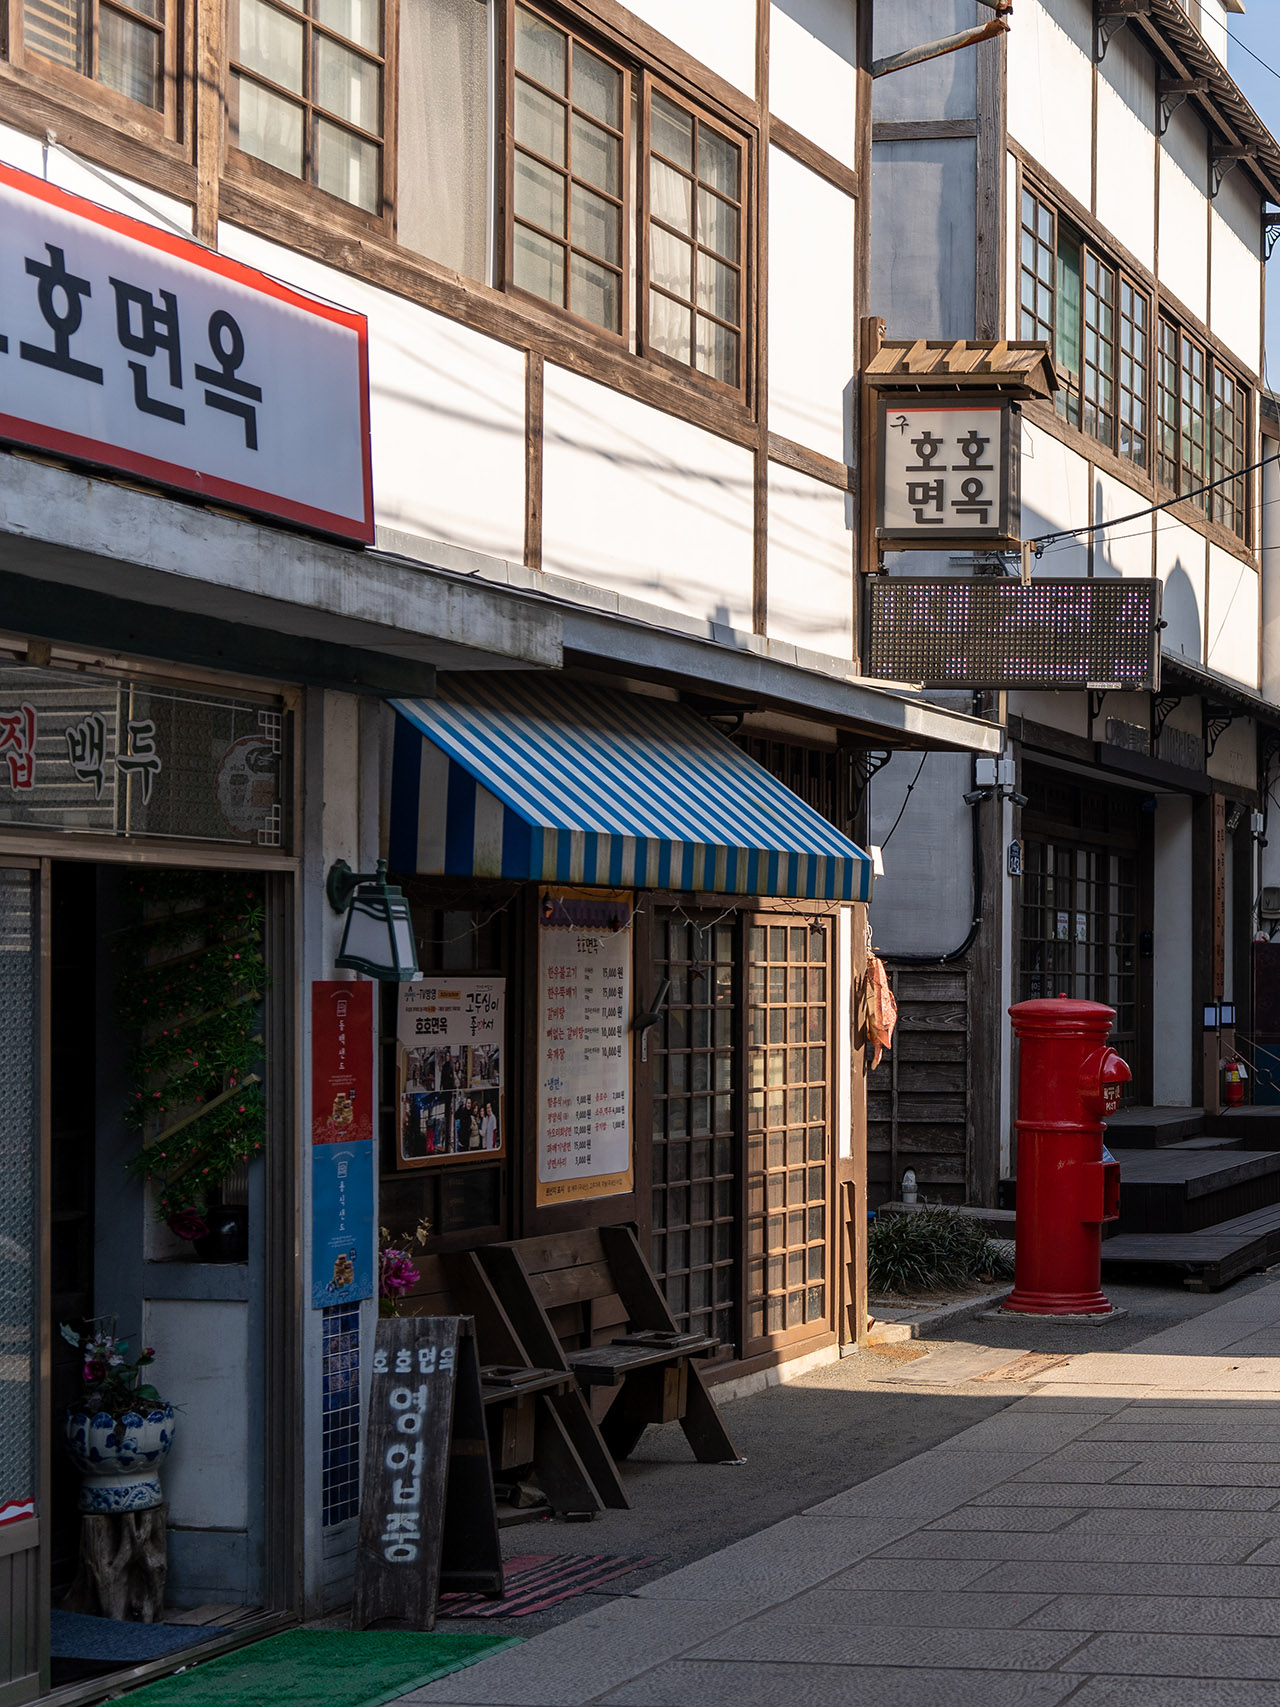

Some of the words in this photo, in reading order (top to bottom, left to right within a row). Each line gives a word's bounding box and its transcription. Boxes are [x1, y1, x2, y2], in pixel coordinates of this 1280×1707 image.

[0, 242, 263, 450] 호면옥
[889, 414, 910, 436] 구
[905, 430, 994, 472] 호호
[905, 476, 994, 525] 면옥
[416, 1017, 447, 1034] 호호면옥
[547, 1007, 565, 1020] 갈비탕
[372, 1346, 455, 1377] 호호면옥
[381, 1384, 428, 1563] 영업중
